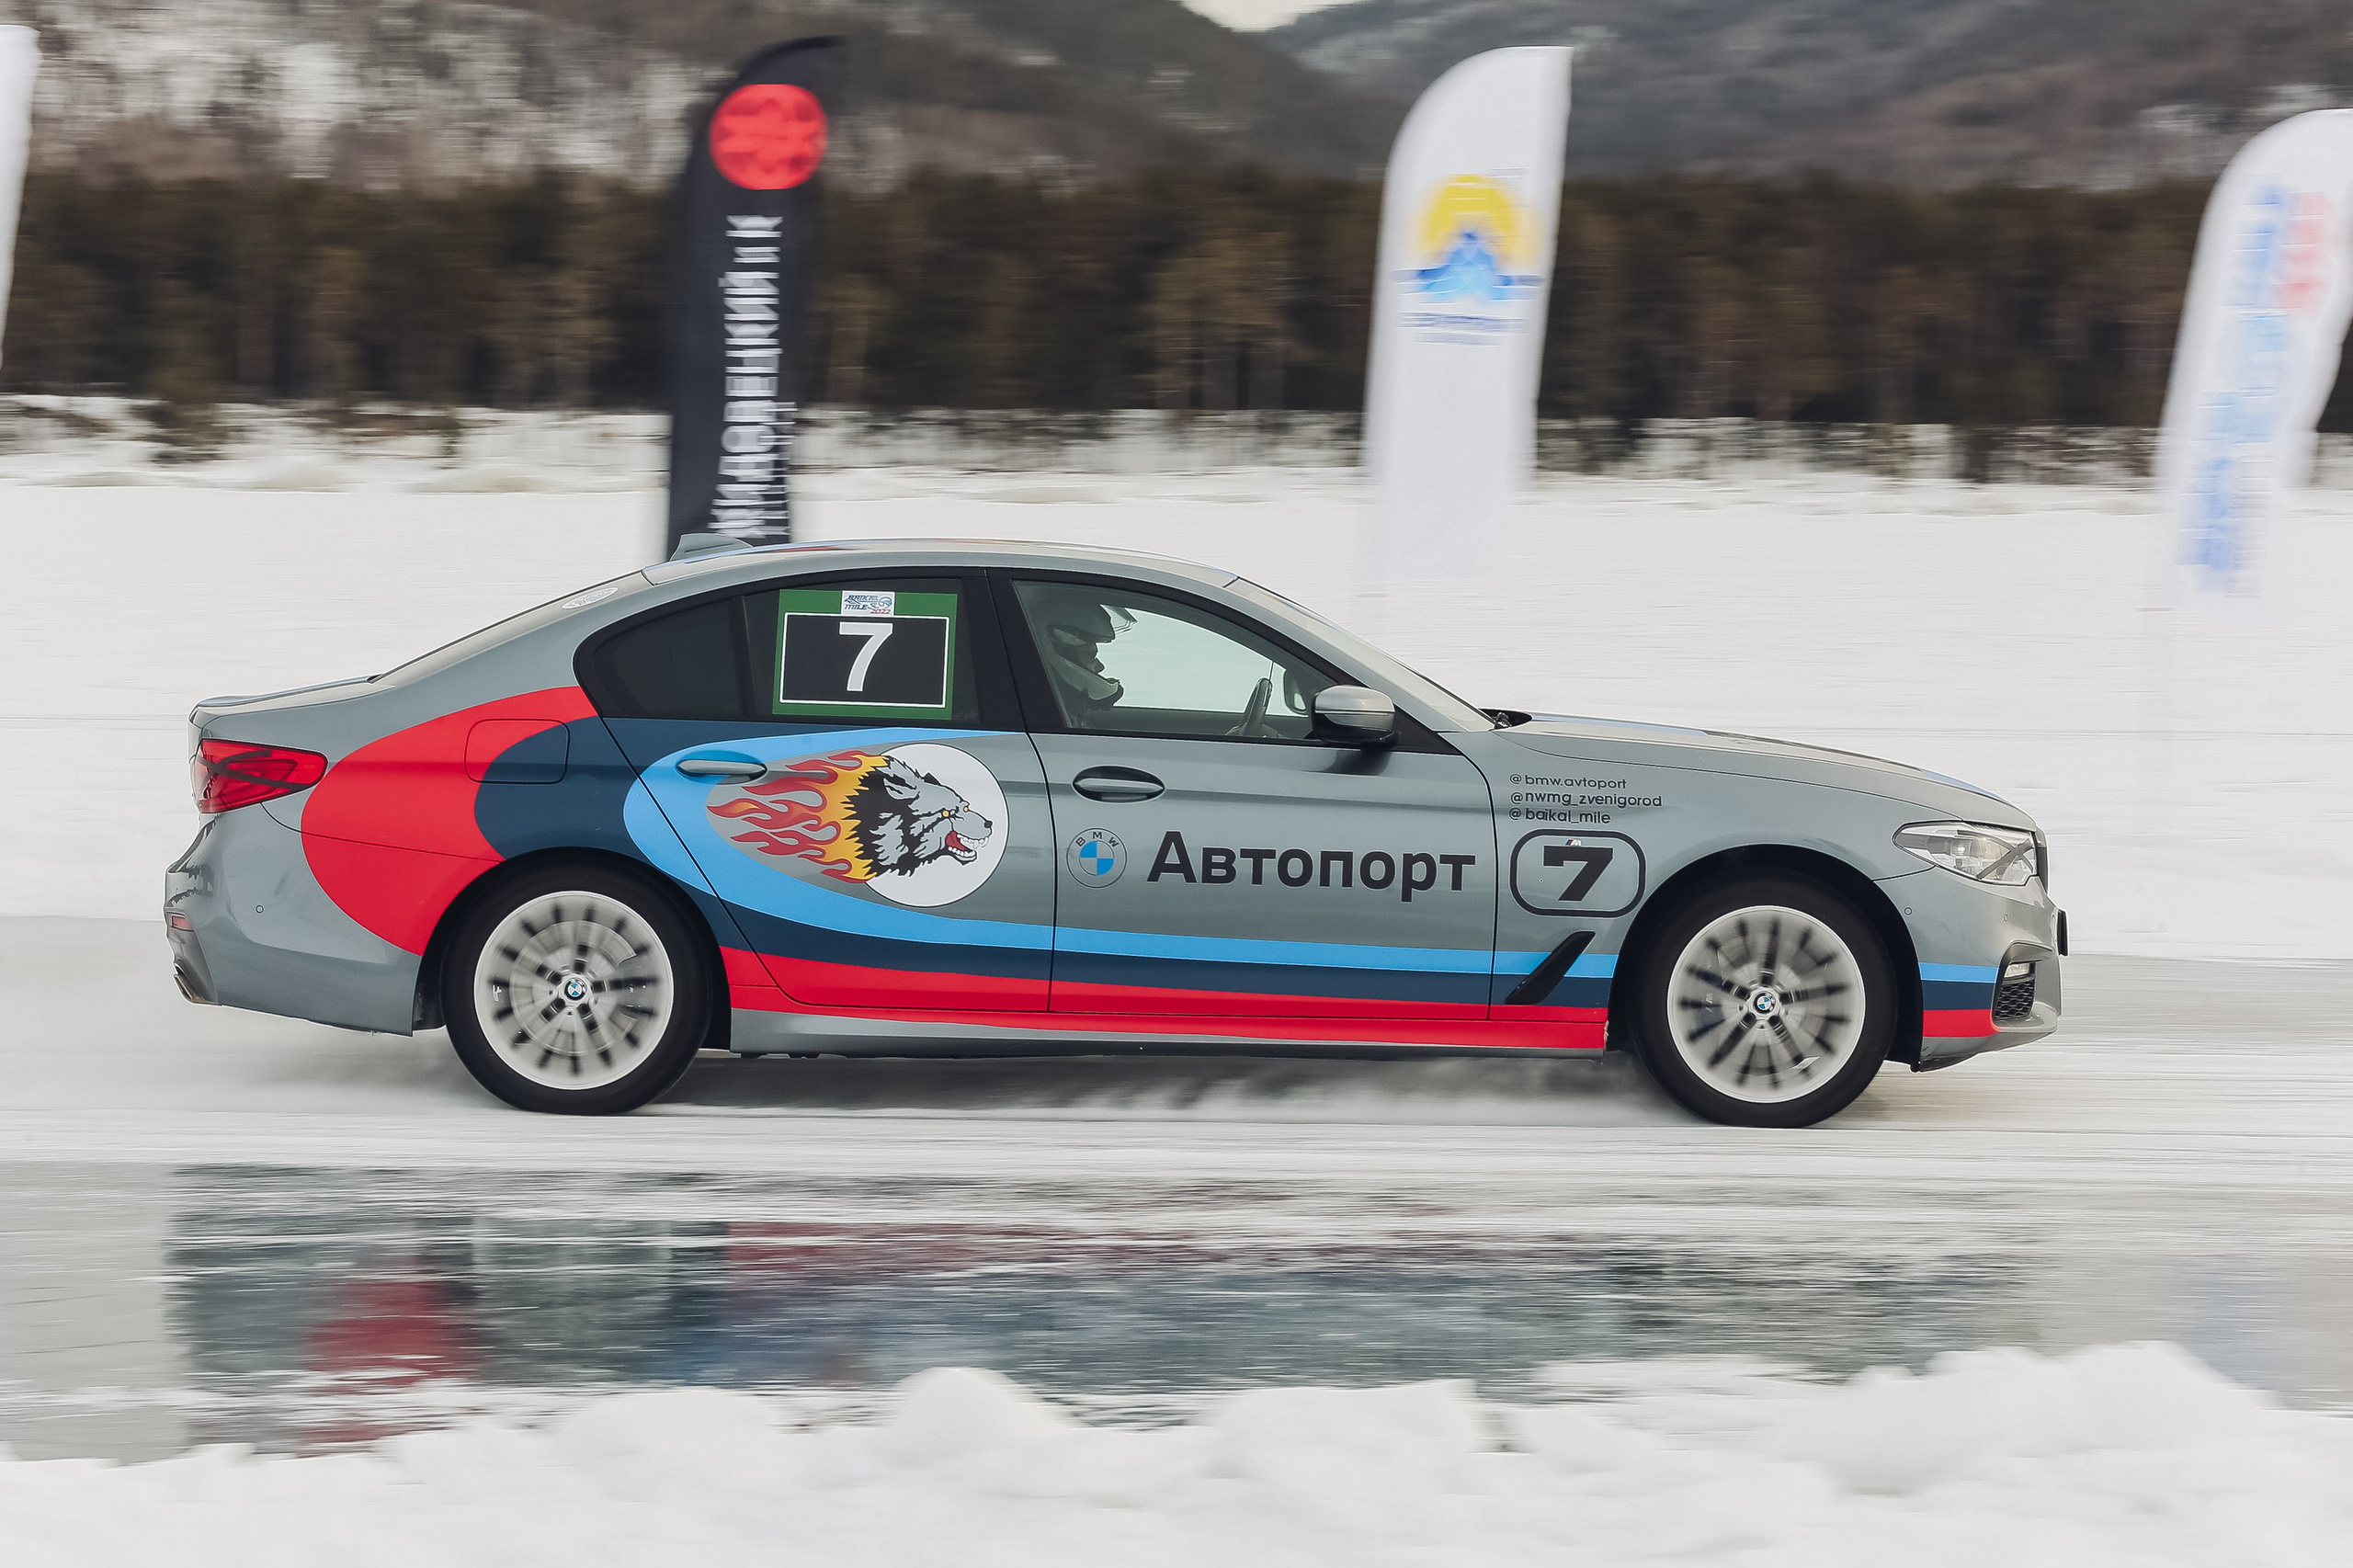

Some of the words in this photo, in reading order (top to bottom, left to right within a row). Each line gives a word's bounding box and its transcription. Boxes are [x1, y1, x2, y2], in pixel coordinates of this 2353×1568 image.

[839, 622, 893, 691] 7
[1074, 831, 1120, 848] BMW
[1147, 830, 1476, 903] Автопорт
[1542, 845, 1614, 902] 7
